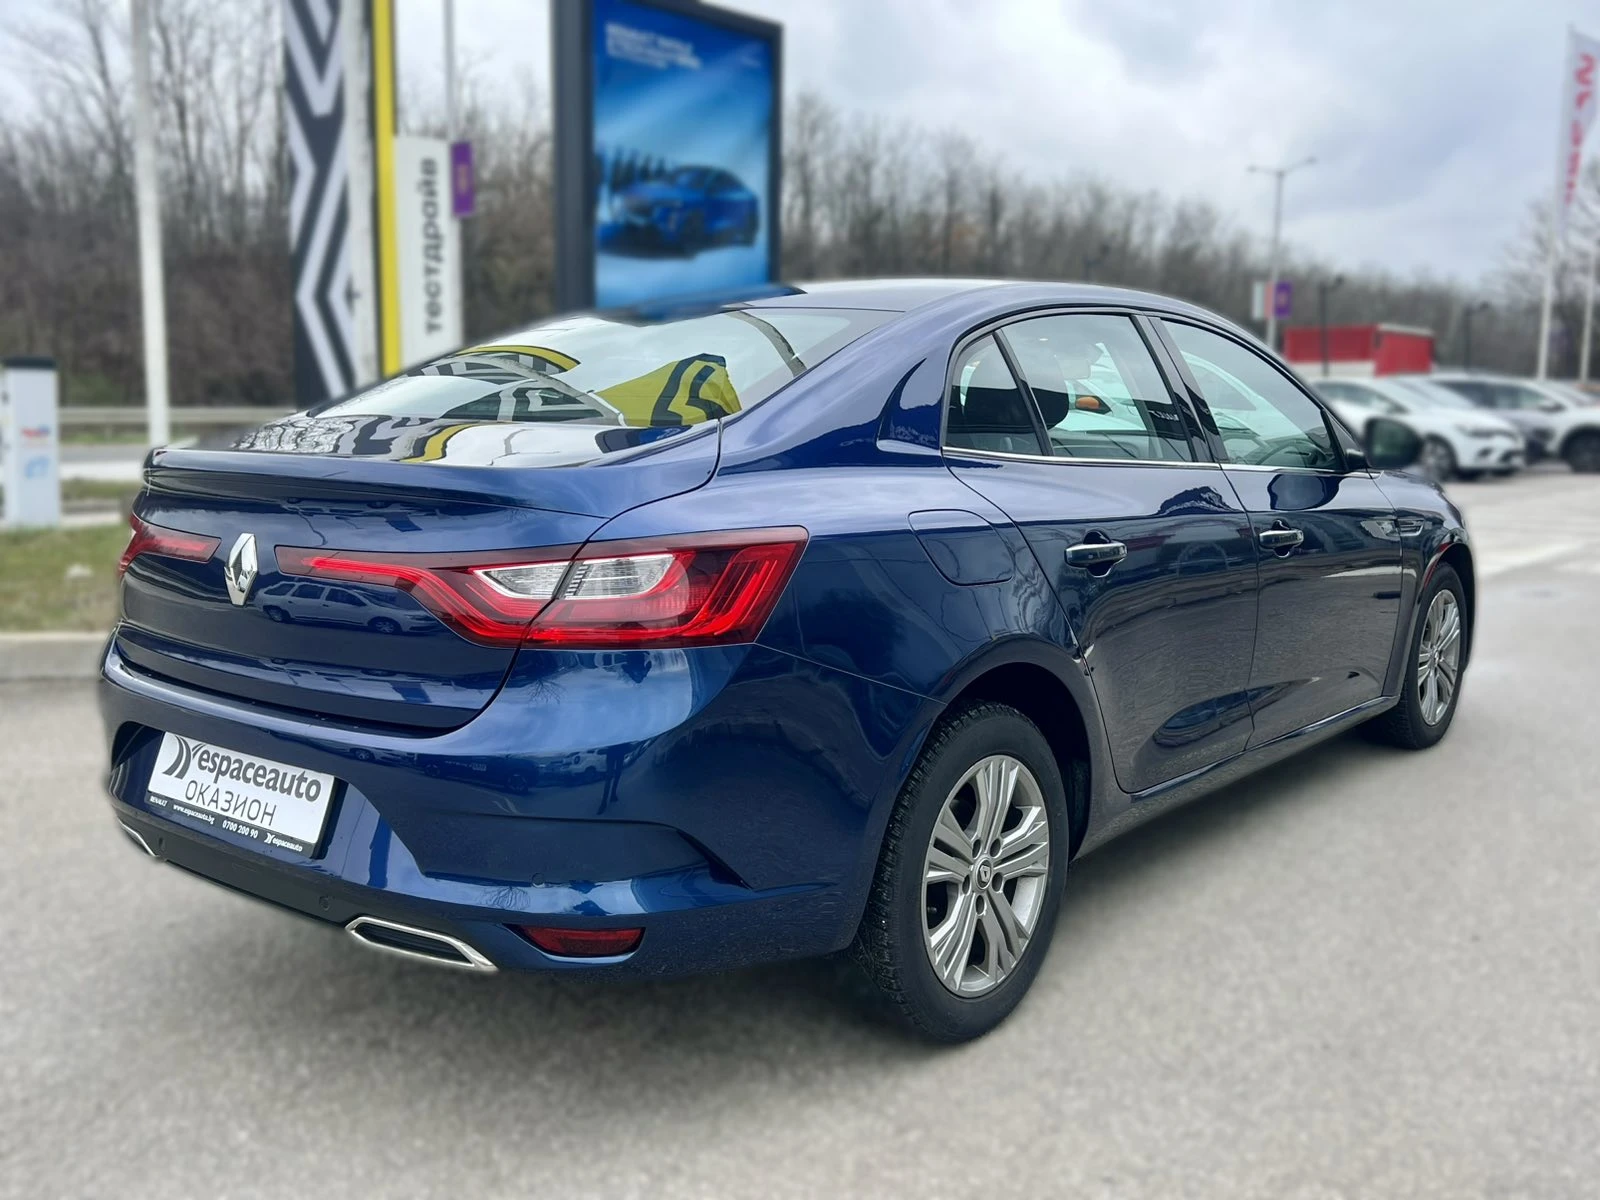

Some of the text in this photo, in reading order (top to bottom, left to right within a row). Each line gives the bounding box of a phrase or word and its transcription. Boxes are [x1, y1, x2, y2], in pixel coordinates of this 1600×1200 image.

[418, 157, 443, 335] тестдрайв
[197, 749, 322, 802] espaceauto
[173, 804, 215, 825] www.espaceauto.bg
[222, 819, 238, 832] 0700
[237, 825, 250, 836] 200
[249, 829, 259, 839] 90
[272, 838, 303, 852] espaceauto
[185, 780, 277, 826] ОКАЗИОН
